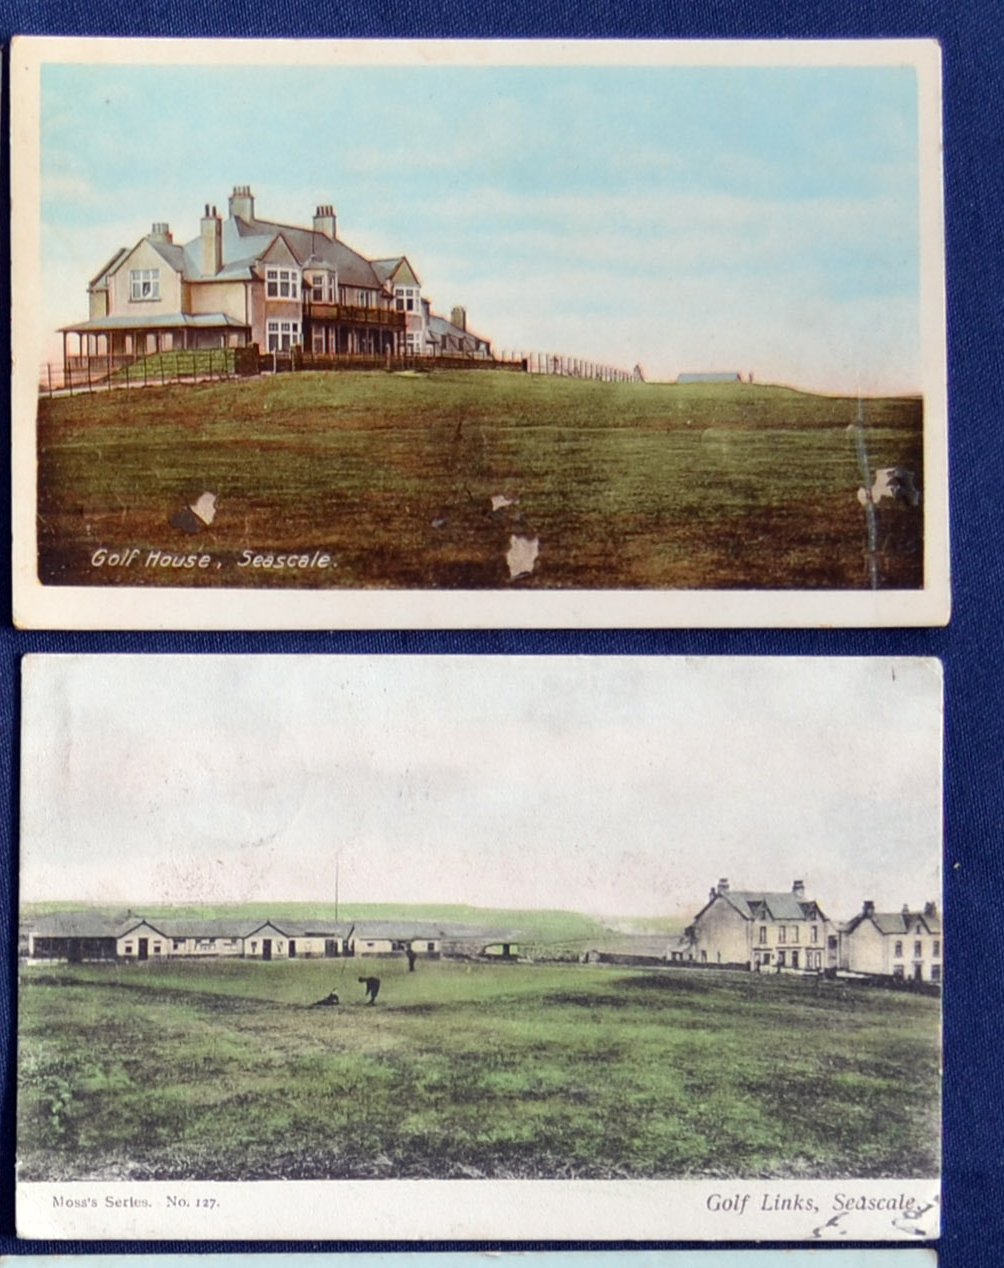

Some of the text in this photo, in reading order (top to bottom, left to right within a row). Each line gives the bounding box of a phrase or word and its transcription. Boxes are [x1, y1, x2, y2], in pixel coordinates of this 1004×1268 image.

[91, 548, 338, 570] Golf House, Seascale.
[52, 1195, 220, 1210] Moss's Series. No. 127.
[706, 1193, 750, 1215] Golf
[761, 1193, 819, 1212] Links,
